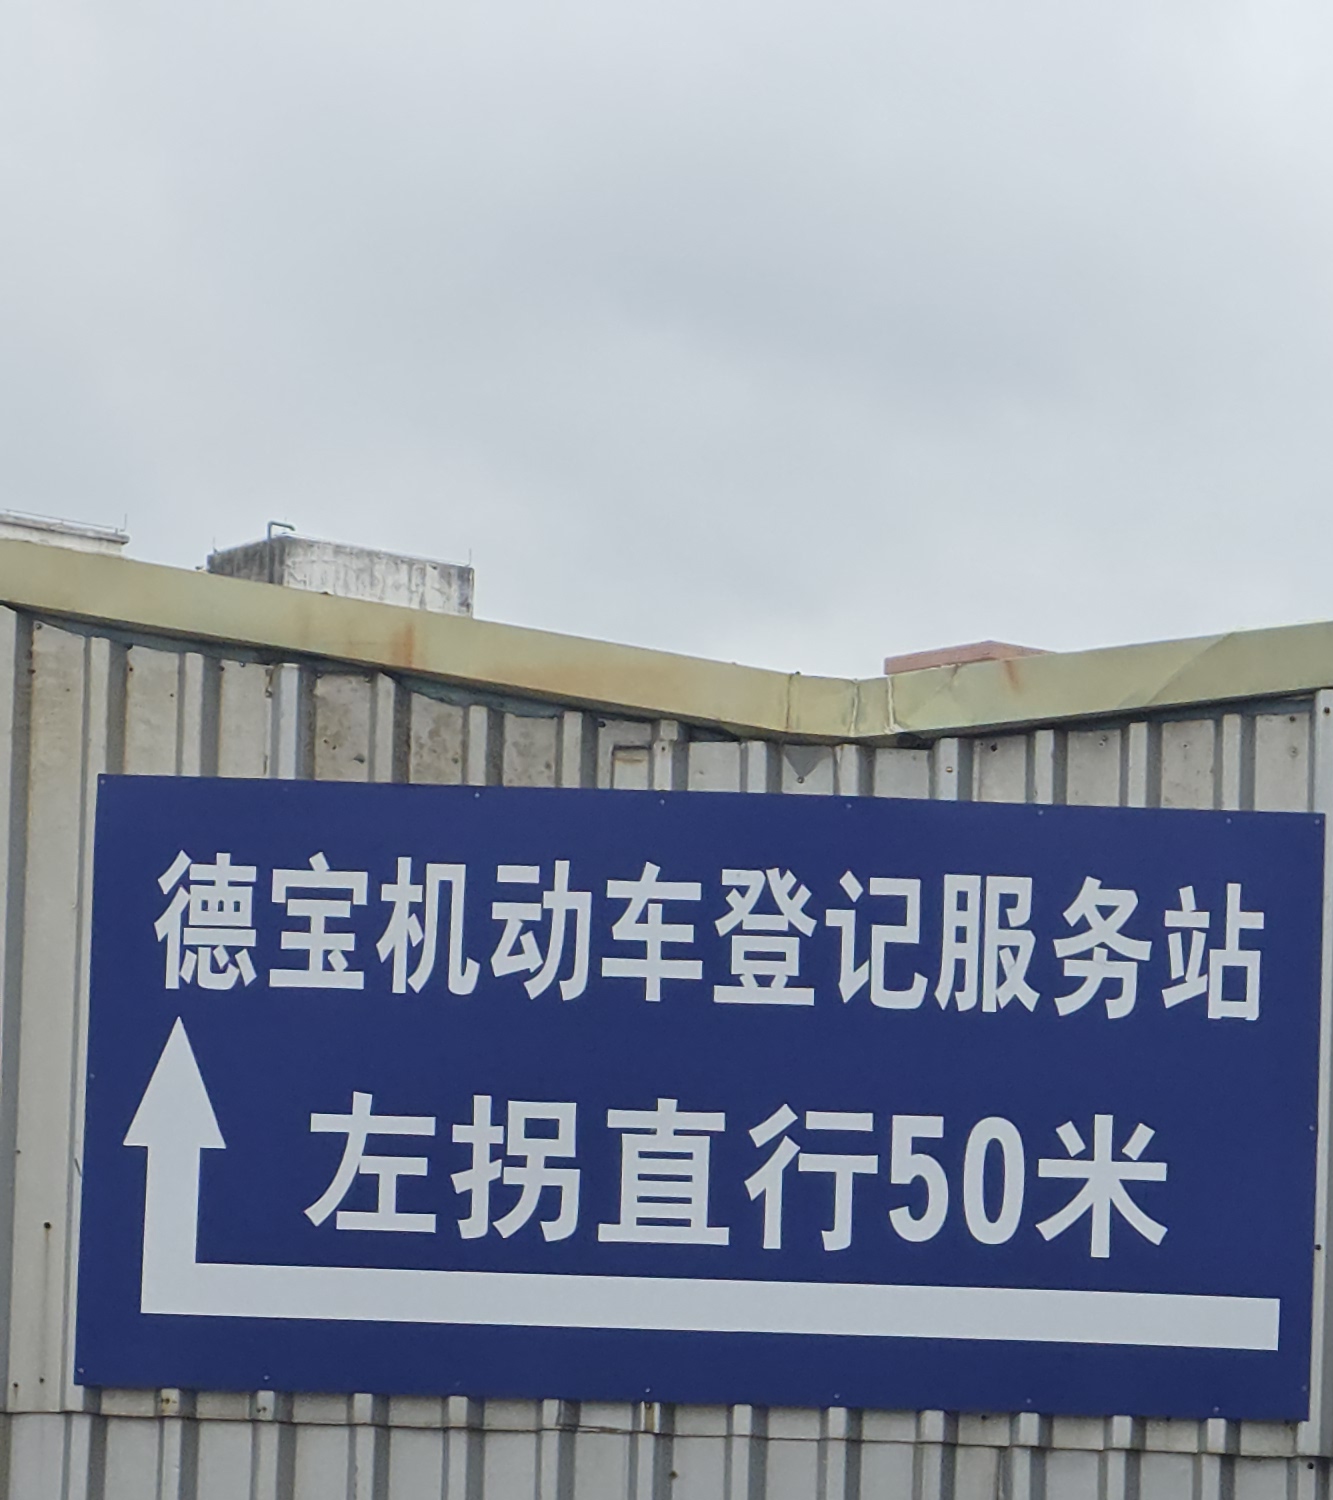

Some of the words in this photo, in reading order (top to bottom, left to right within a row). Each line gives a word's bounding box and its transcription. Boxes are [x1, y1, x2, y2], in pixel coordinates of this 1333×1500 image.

[155, 851, 1264, 1020] 德宝机动车登记服务站
[304, 1092, 1168, 1258] 左拐直行50米
